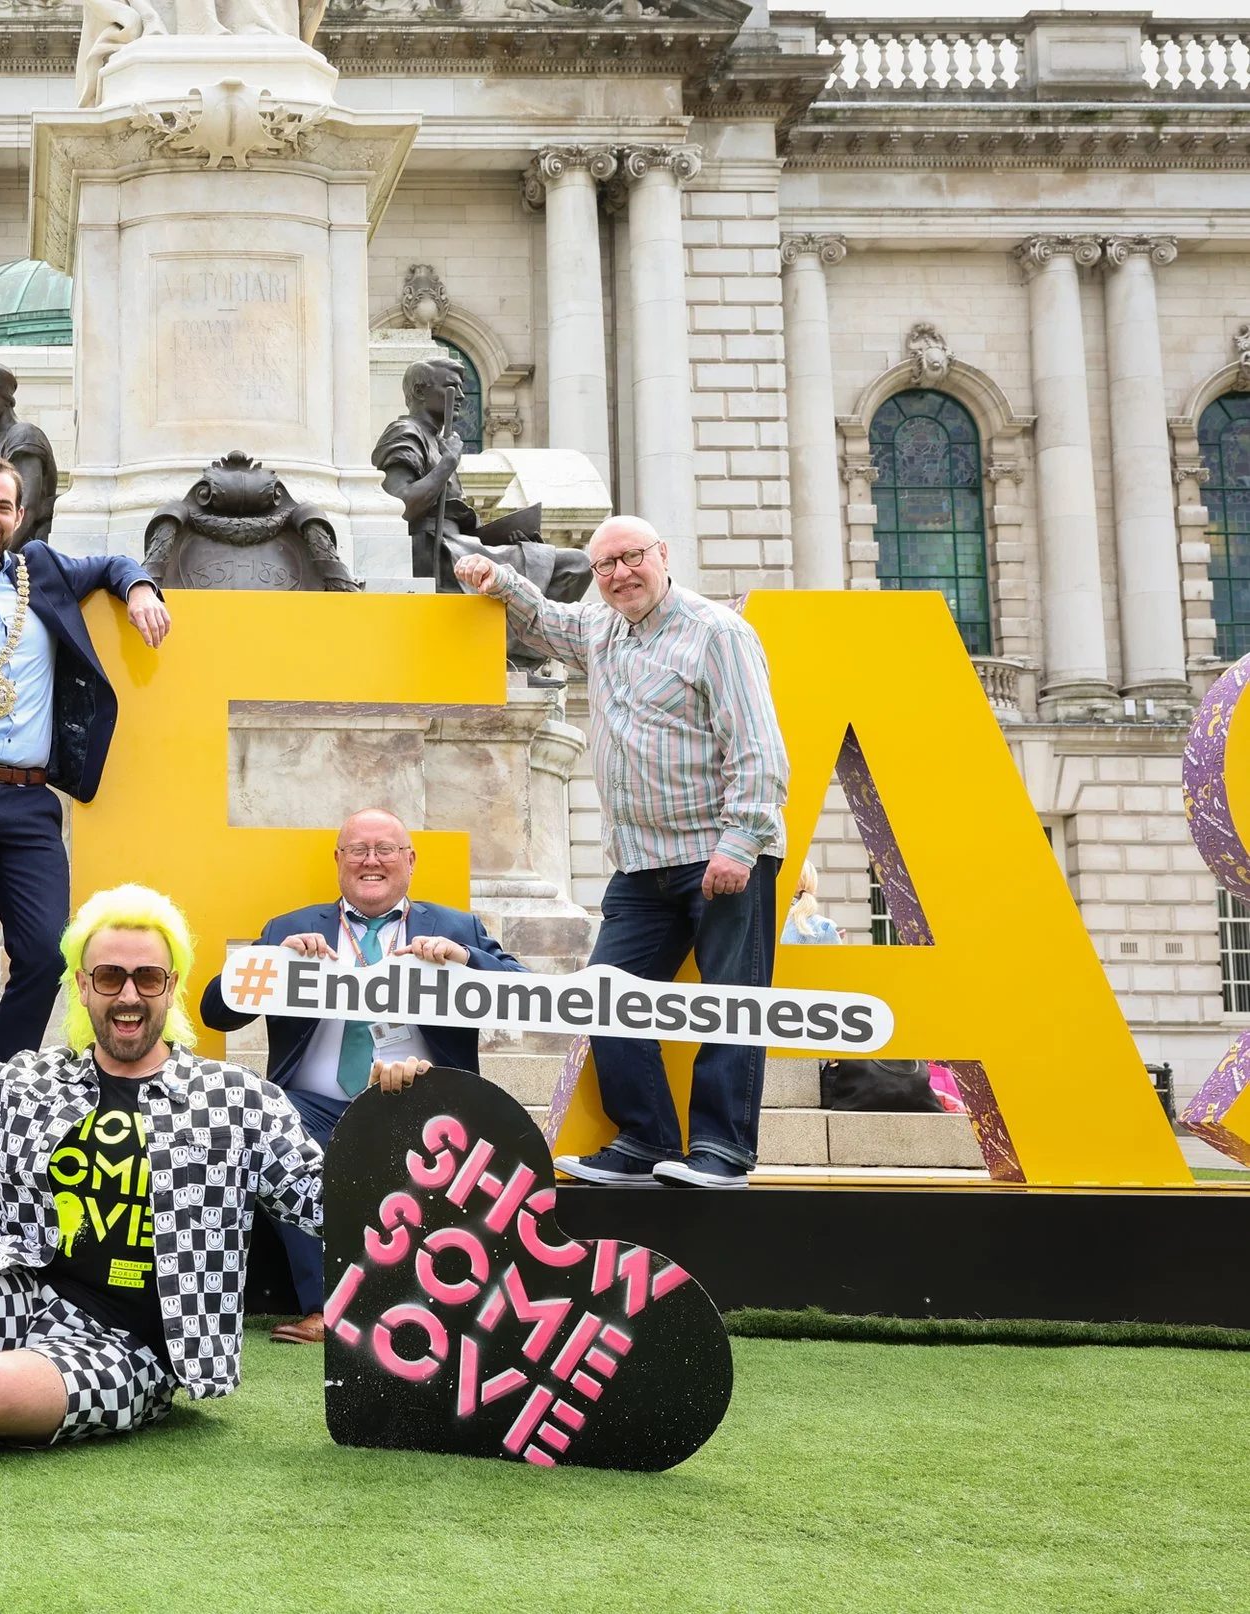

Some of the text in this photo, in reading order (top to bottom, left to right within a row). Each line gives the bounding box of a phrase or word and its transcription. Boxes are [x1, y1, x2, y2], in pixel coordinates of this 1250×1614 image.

[230, 956, 874, 1043] #EndHomelessness
[364, 1191, 634, 1402] SOME
[405, 1114, 692, 1319] SHOW
[324, 1262, 587, 1468] LOVE
